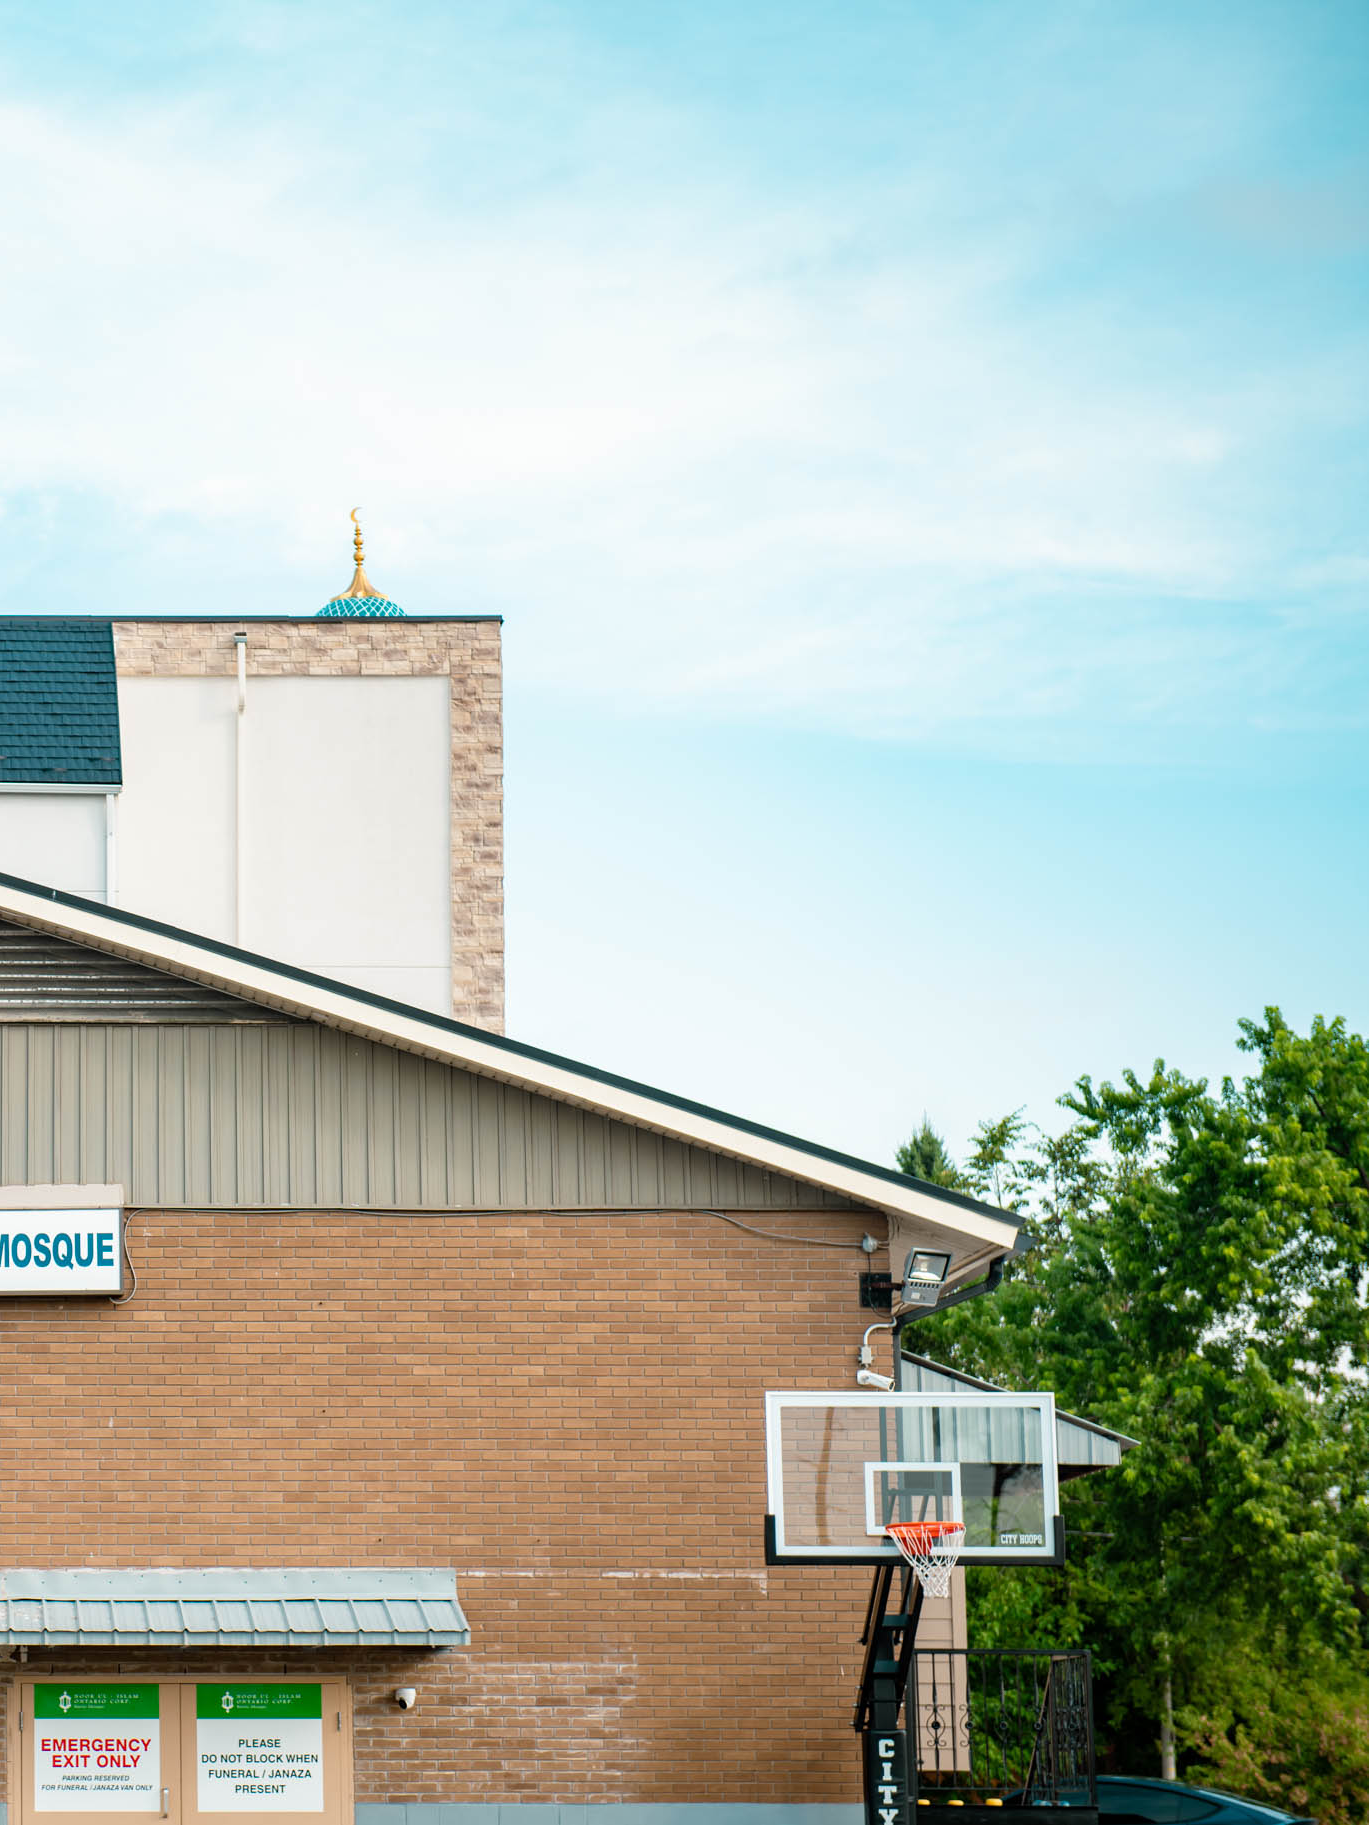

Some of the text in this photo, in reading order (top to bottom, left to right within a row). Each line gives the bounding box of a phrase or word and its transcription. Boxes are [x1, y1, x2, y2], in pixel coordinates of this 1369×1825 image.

[1000, 1533, 1043, 1545] CITY HOOPS
[41, 1738, 151, 1752] EMERGENCY
[238, 1739, 281, 1748] PLEASE
[52, 1754, 140, 1768] EXIT ONLY
[201, 1754, 318, 1763] DO NOT BLOCK WHEN
[208, 1769, 260, 1778] FUNERAL
[268, 1769, 312, 1778] JANAZA
[878, 1738, 899, 1825] CITY
[235, 1785, 286, 1794] PRESENT
